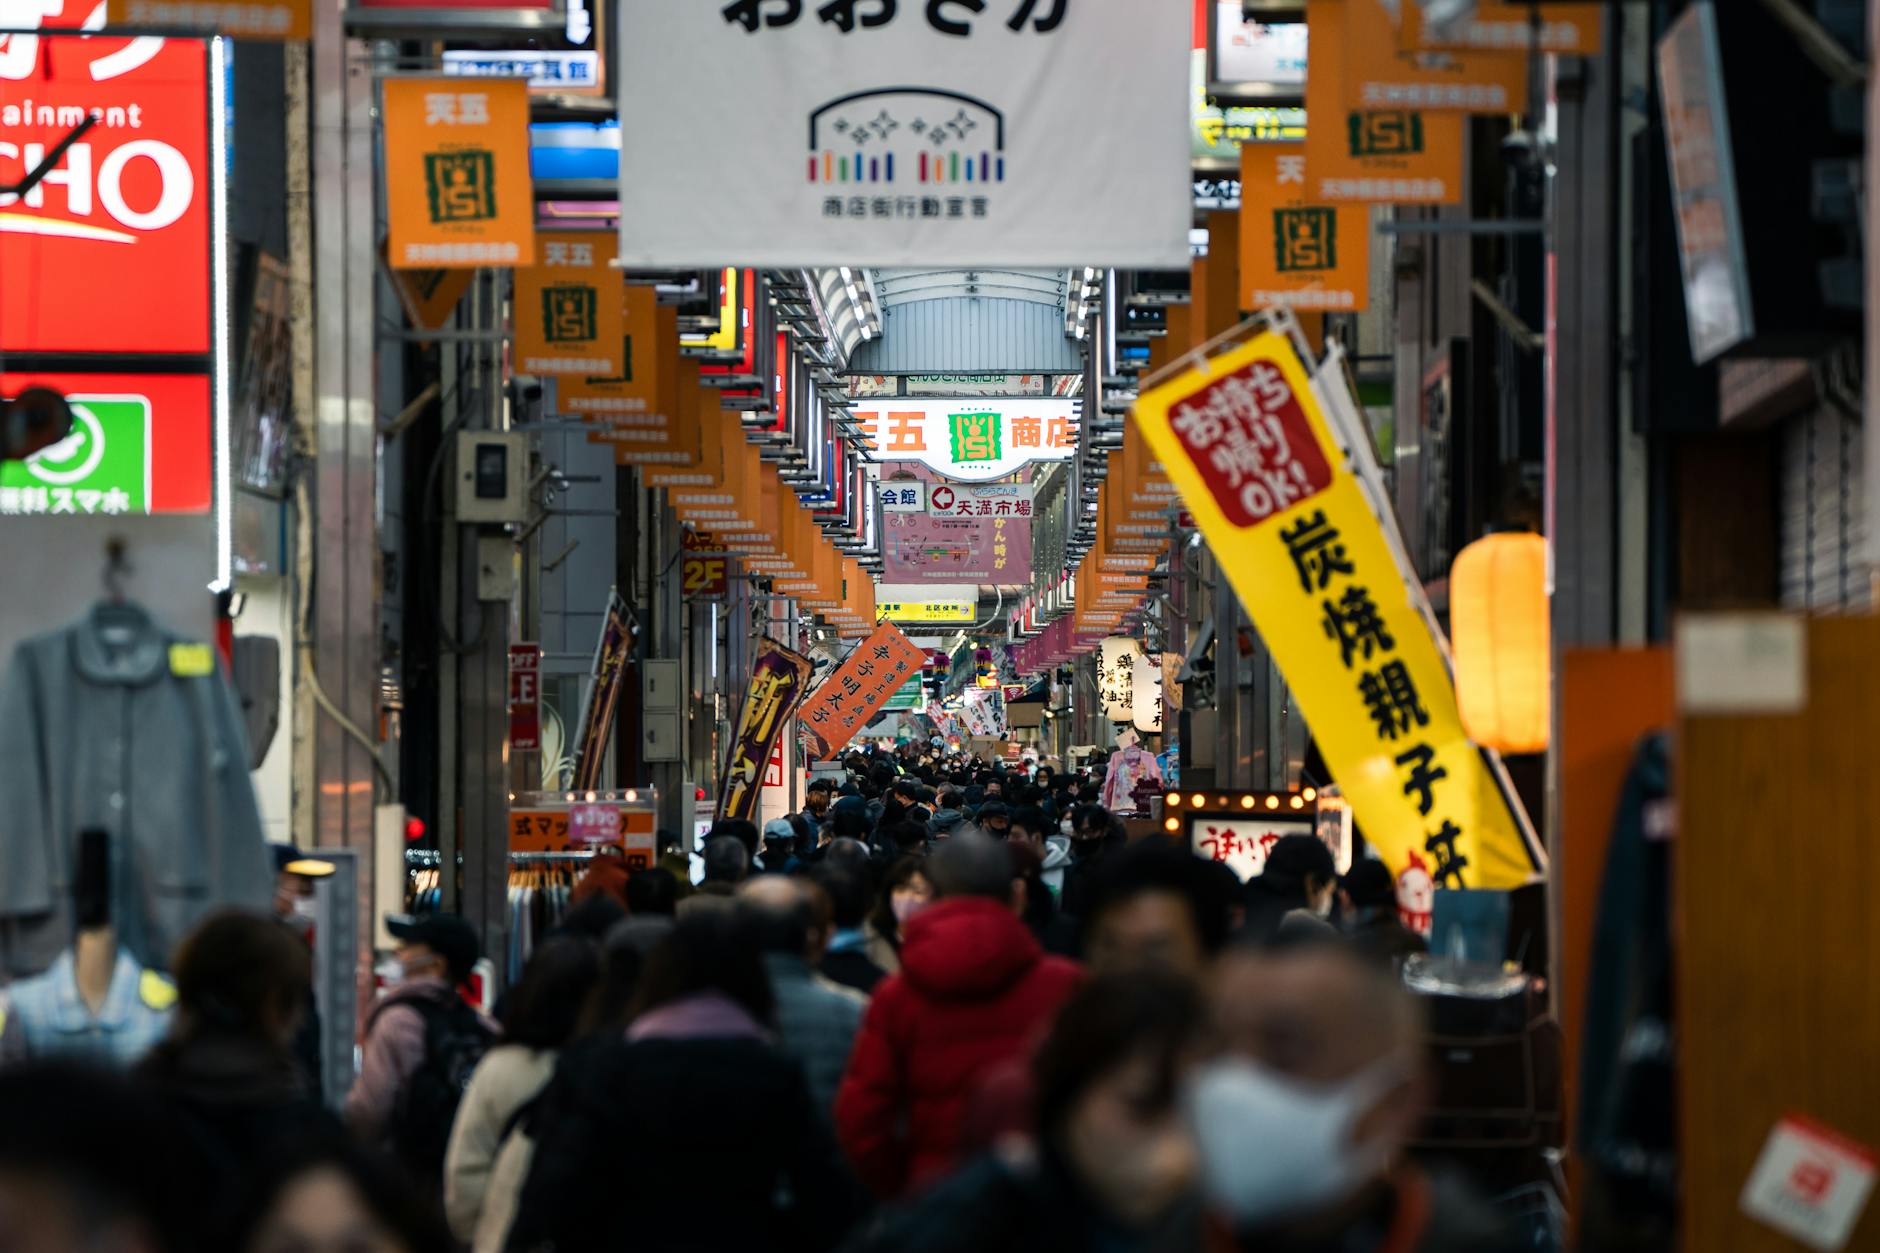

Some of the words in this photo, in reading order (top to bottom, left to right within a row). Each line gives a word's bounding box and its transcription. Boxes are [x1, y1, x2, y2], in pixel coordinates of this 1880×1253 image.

[0, 139, 194, 230] HO
[822, 195, 988, 219] 商店街行動宣言
[1172, 363, 1290, 448] お持ち
[1011, 416, 1077, 448] 商店
[0, 486, 129, 515] 無料スマホ
[881, 488, 917, 505] 会館
[1239, 459, 1315, 517] OK!
[956, 500, 1033, 516] 天満市場
[684, 560, 725, 589] 2F
[811, 645, 890, 724] 辛子明太子
[1279, 508, 1470, 890] 炭焼親子丼
